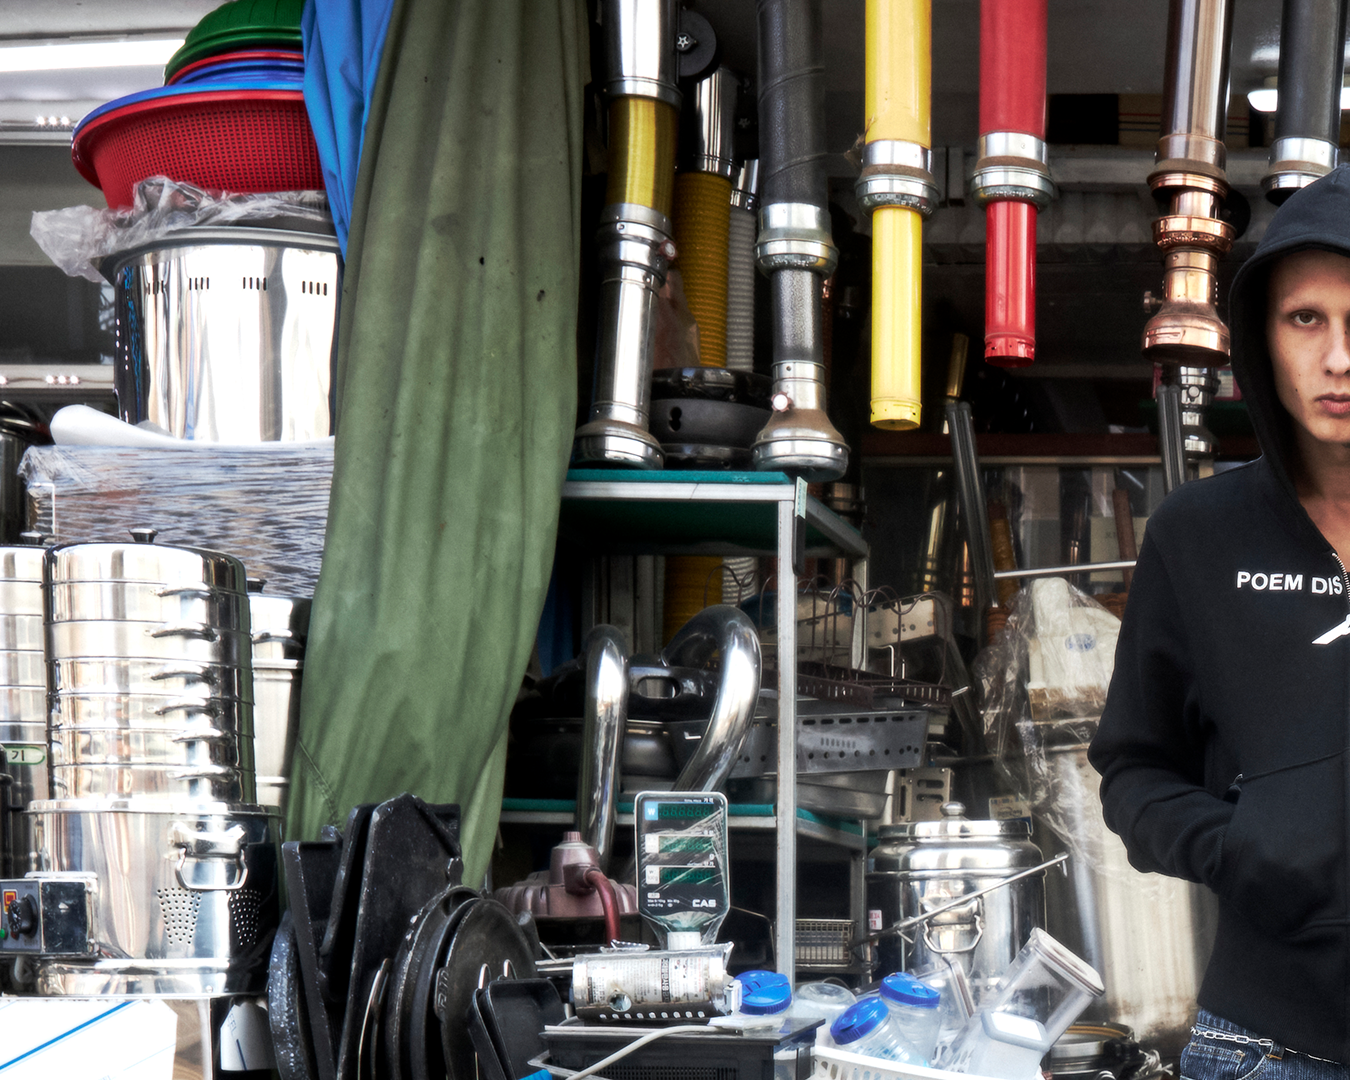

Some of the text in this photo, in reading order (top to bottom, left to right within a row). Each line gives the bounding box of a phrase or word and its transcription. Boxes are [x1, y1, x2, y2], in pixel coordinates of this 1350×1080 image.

[1236, 571, 1304, 591] POEM
[11, 749, 25, 762] 기
[692, 899, 717, 908] CAS
